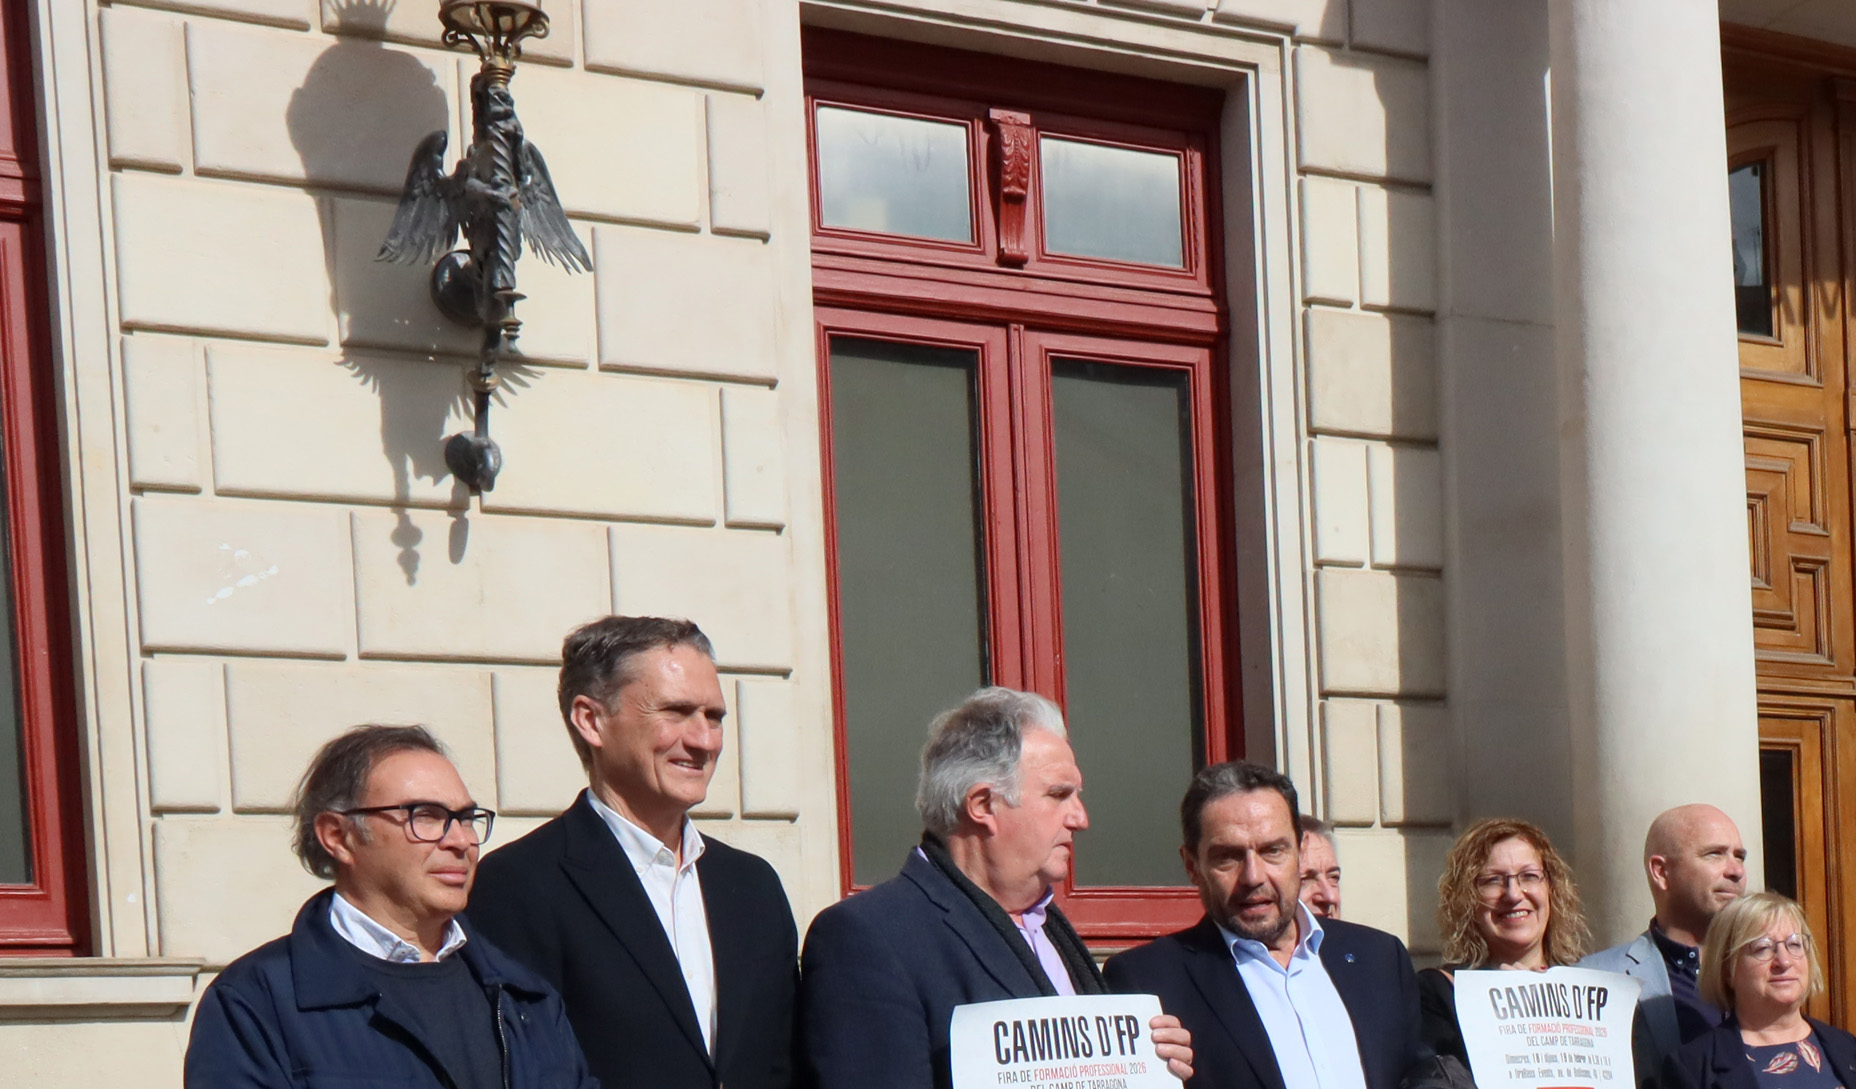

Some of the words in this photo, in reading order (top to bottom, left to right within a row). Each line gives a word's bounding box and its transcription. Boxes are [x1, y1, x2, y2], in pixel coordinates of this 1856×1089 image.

[1489, 983, 1570, 1020] CAMINS
[1572, 985, 1608, 1021] D'FP
[993, 1016, 1093, 1065] CAMINS
[1096, 1015, 1140, 1057] D'FP
[1499, 1025, 1516, 1035] FIRA
[1517, 1024, 1527, 1034] DE
[1527, 1036, 1539, 1046] DEL
[1541, 1036, 1558, 1046] CAMP
[1560, 1036, 1568, 1046] DE
[998, 1071, 1018, 1084] FIRA
[1020, 1070, 1031, 1082] DE
[1034, 1063, 1077, 1081] FORMACIÓ
[1080, 1062, 1128, 1077] PROFESSIONAL
[1129, 1062, 1146, 1074] 2026
